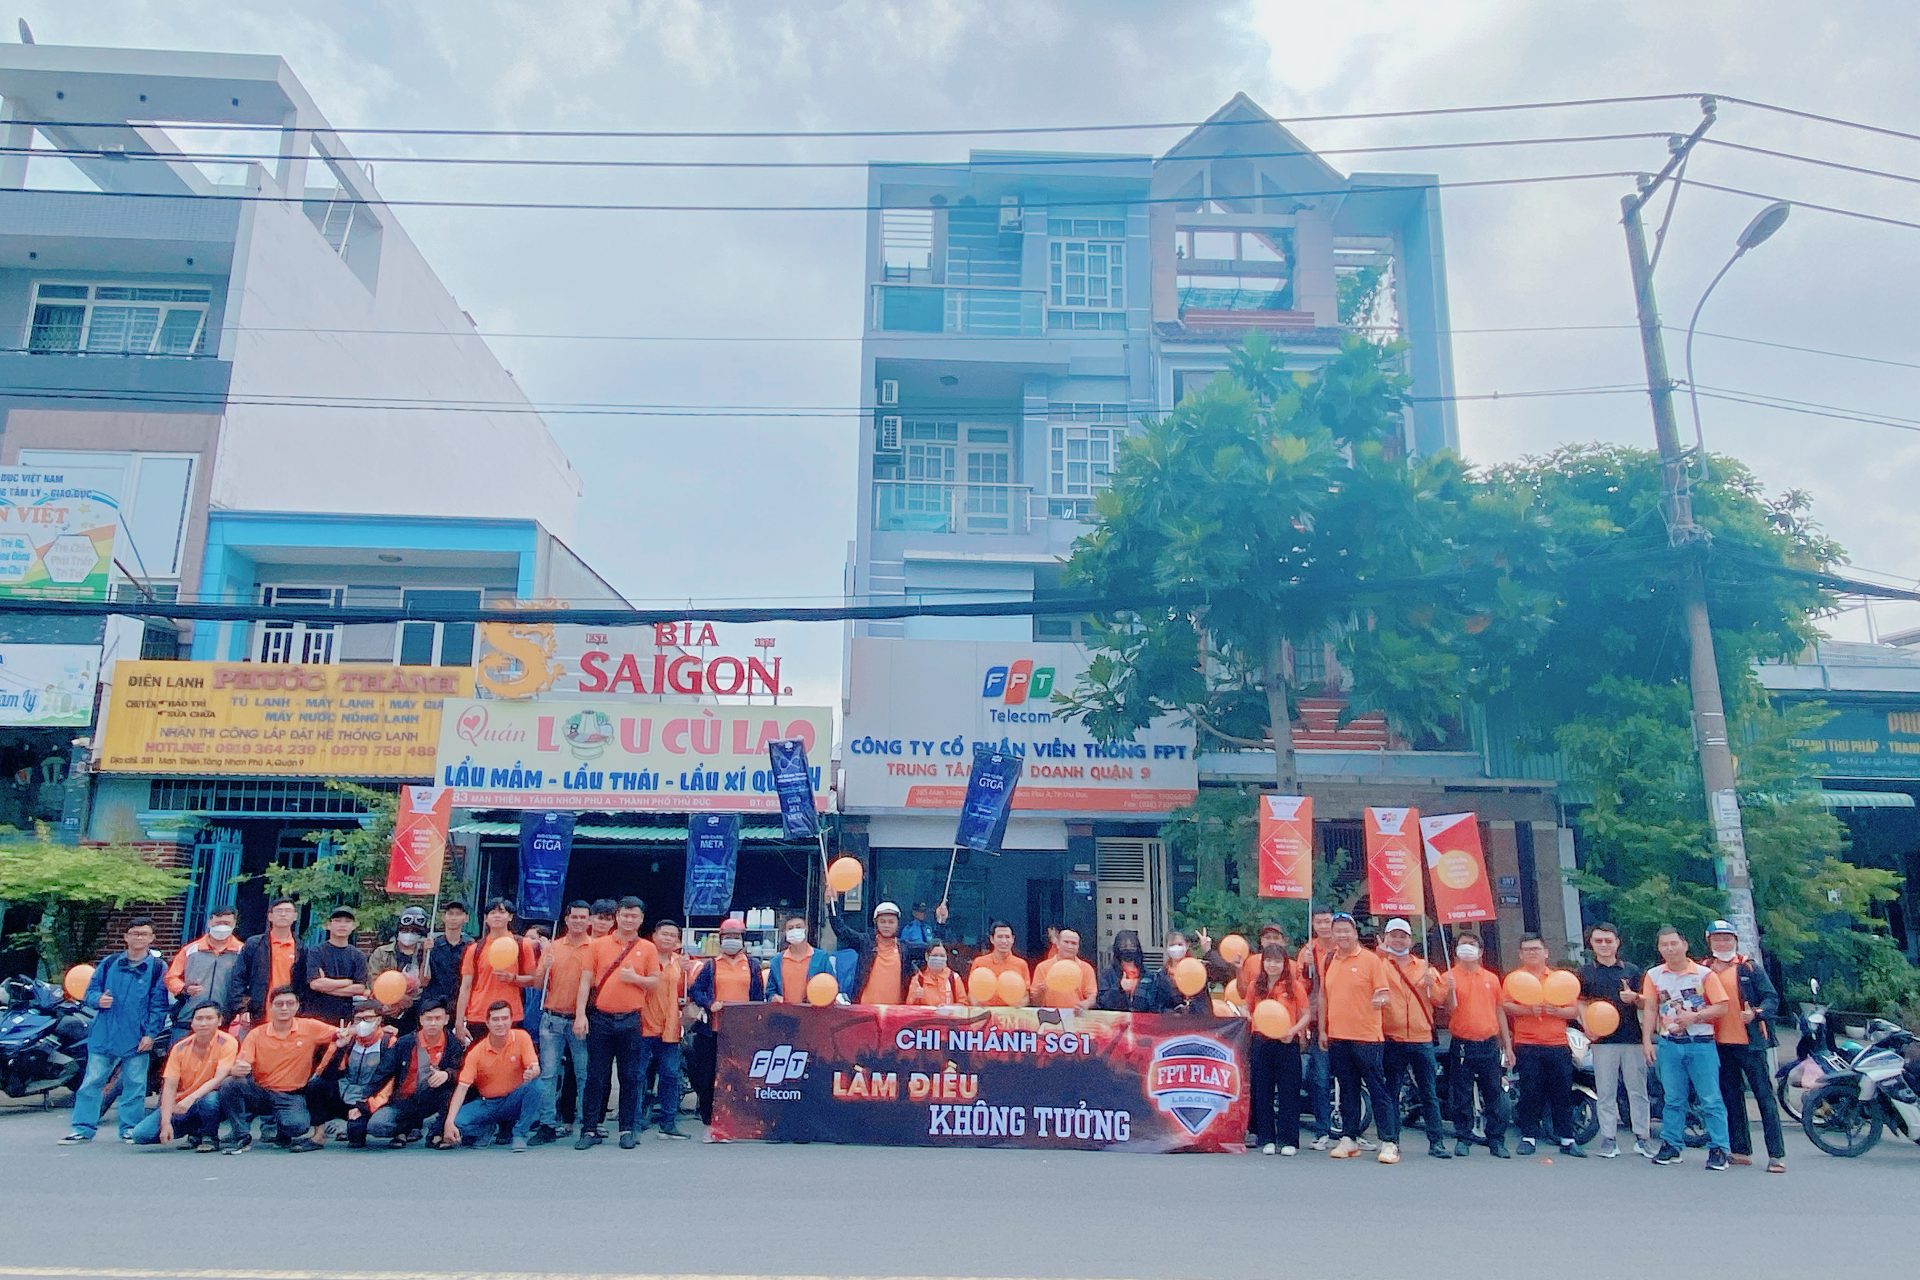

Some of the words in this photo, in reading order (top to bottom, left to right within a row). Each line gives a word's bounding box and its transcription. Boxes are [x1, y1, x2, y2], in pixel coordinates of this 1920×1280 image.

[17, 502, 69, 528] VIỆT
[654, 622, 720, 647] BIA
[166, 676, 204, 689] LẠNH
[579, 650, 782, 696] SAIGON
[990, 708, 1052, 723] Telecom
[199, 727, 215, 738] THI
[219, 725, 259, 739] CÔNG
[456, 705, 526, 747] Quán
[661, 708, 722, 755] CÙ
[850, 736, 902, 755] CÔNG
[909, 740, 935, 756] TY
[940, 735, 964, 756] CỔ
[1083, 740, 1146, 759] THÔNG
[1153, 745, 1187, 760] FPT
[490, 760, 543, 789] MẮM
[609, 767, 660, 791] THÁI
[724, 765, 747, 791] XÍ
[887, 763, 938, 776] TRUNG
[1030, 765, 1084, 779] DOANH
[1090, 763, 1132, 781] QUẬN
[1141, 768, 1150, 779] 9
[471, 796, 493, 804] MAN
[700, 839, 725, 849] META
[896, 1028, 940, 1051] CHI
[948, 1026, 1037, 1053] NHÁNH
[1045, 1032, 1090, 1054] SG1
[832, 1063, 897, 1098] LÀM
[908, 1060, 978, 1099] ĐIỀU
[1157, 1064, 1187, 1085] FPT
[1189, 1064, 1231, 1088] PLAY
[754, 1087, 801, 1100] Telecom
[929, 1100, 1026, 1137] KHÔNG
[1034, 1101, 1131, 1142] TƯỞNG
